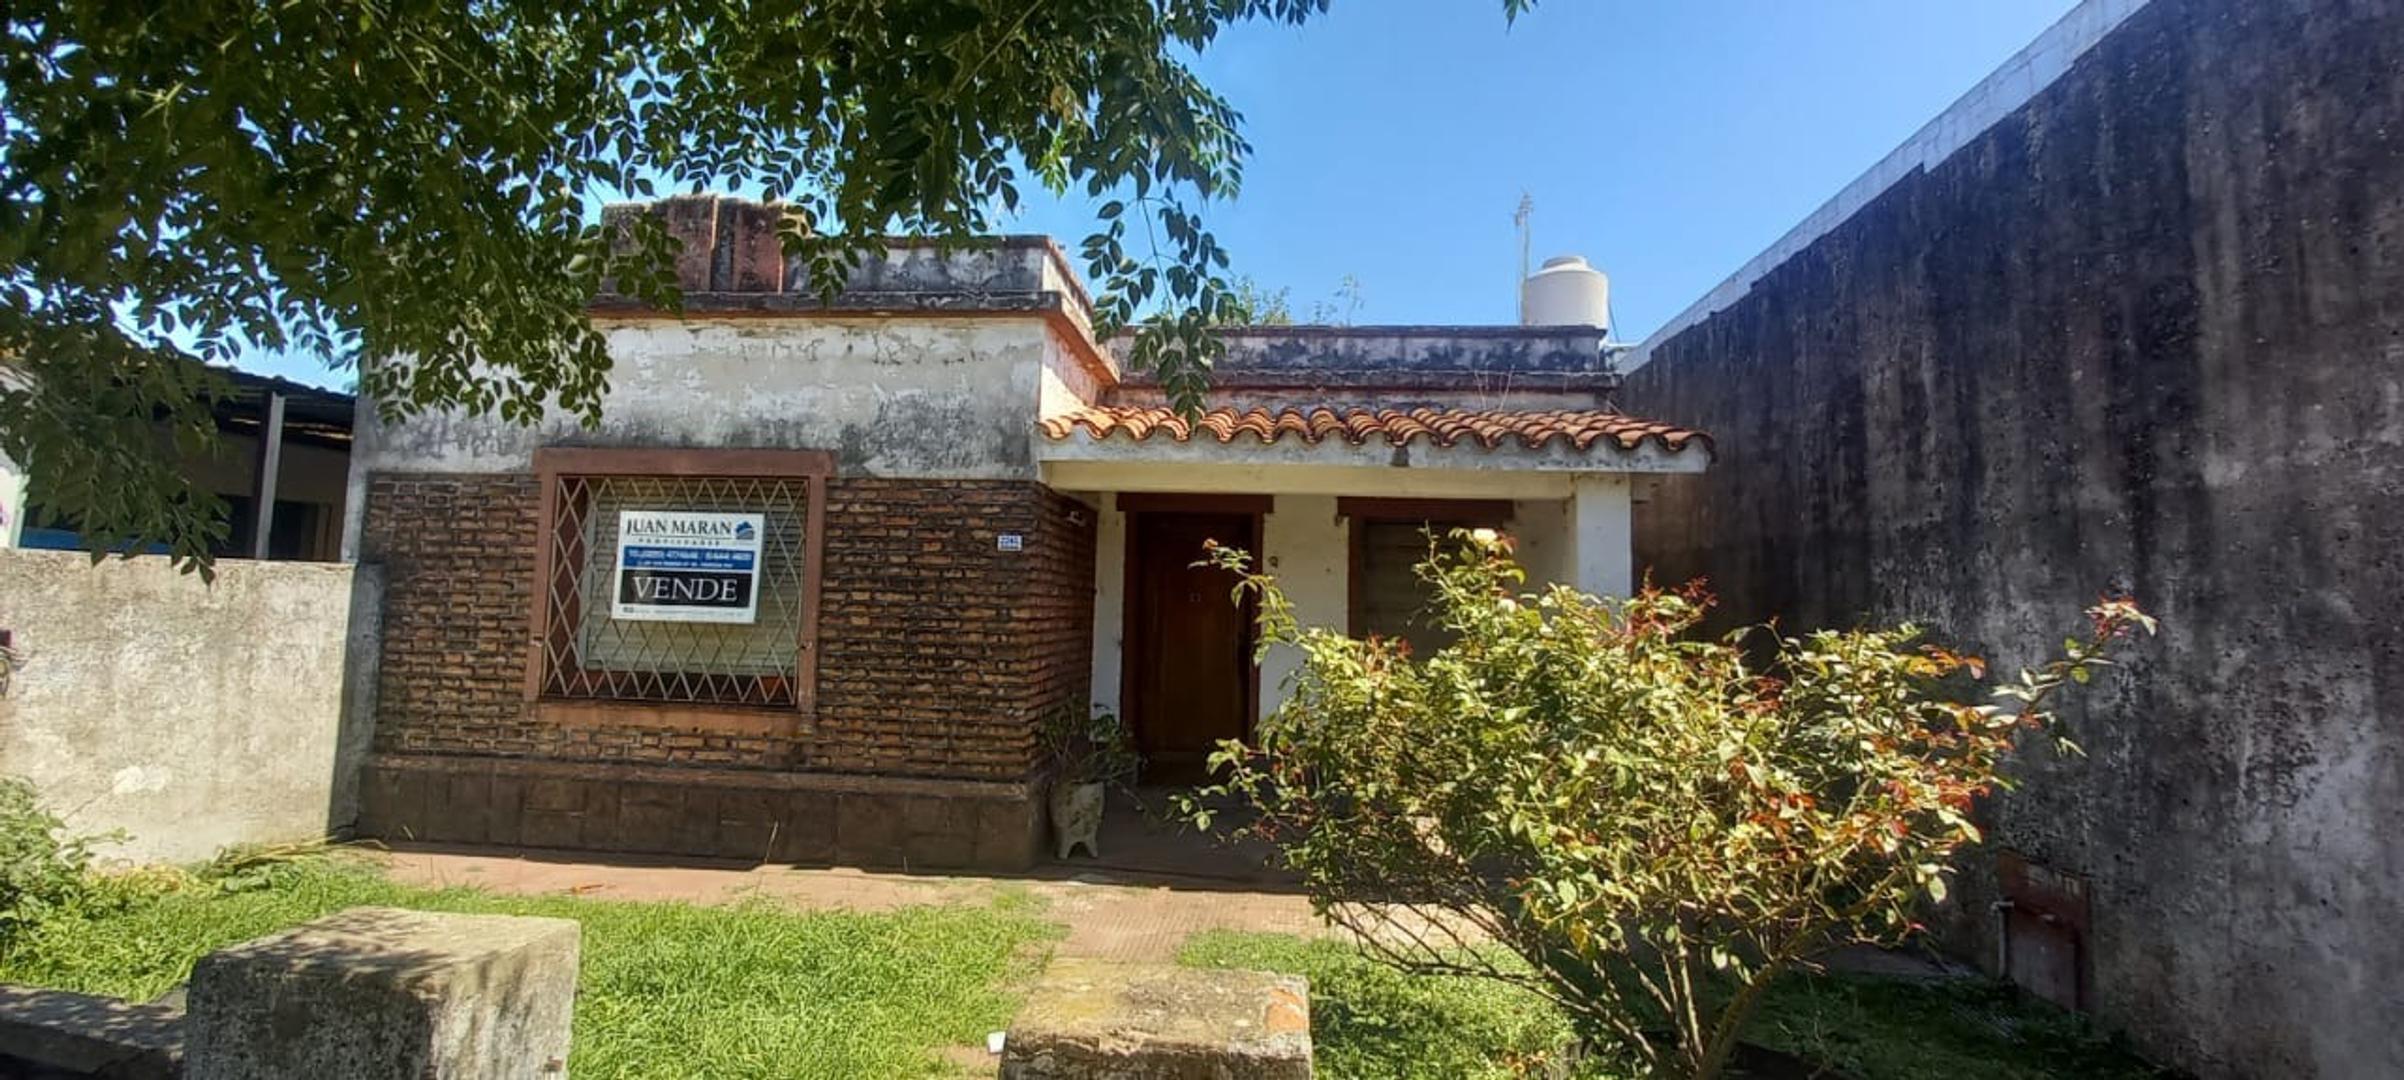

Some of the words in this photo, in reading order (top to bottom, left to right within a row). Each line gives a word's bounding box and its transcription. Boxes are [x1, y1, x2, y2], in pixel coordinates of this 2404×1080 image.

[626, 518, 667, 535] JUAN
[671, 520, 732, 535] MARAN
[632, 576, 737, 601] VENDE
